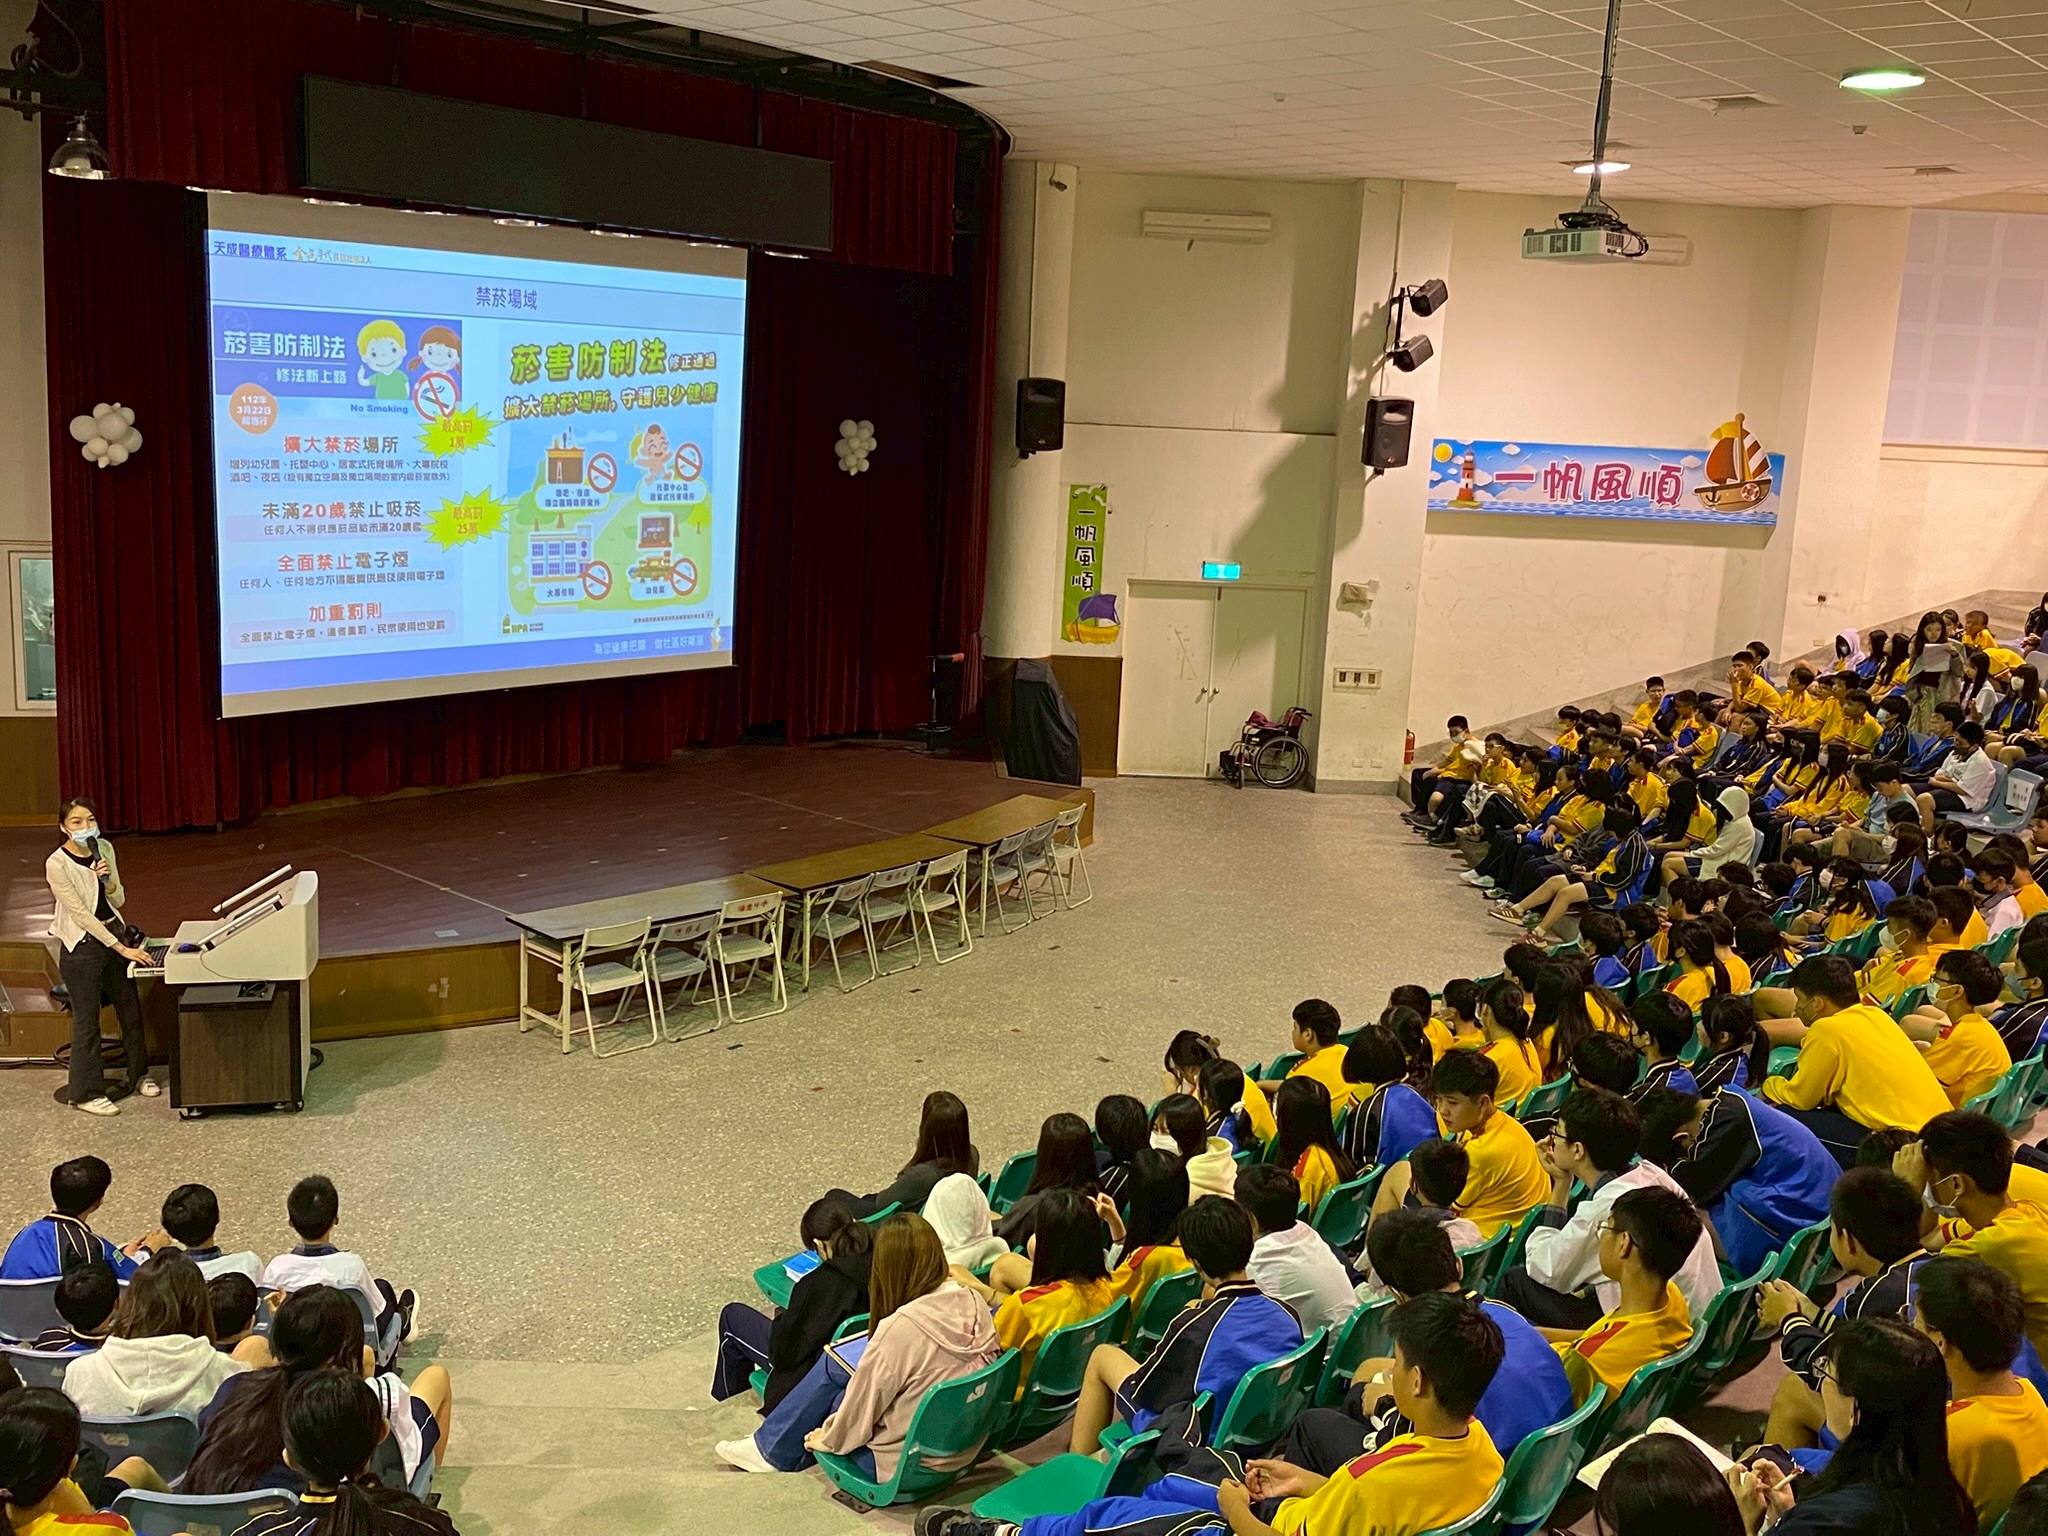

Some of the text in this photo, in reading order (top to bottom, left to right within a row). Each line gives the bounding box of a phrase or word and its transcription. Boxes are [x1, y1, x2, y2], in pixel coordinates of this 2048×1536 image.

[213, 241, 287, 260] 天成醫療體系
[476, 286, 537, 310] 禁菸場域
[223, 330, 346, 359] 菸害防制法
[510, 337, 668, 384] 菸害防制法
[276, 367, 347, 385] 修法新上路
[236, 405, 272, 415] 3月22日
[350, 404, 408, 414] No Smoking
[284, 435, 399, 454] 擴大禁菸場所
[1494, 461, 1684, 508] 一帆風順
[262, 501, 421, 520] 未滿20歲禁止吸菸
[1072, 510, 1097, 591] 一帆風順
[277, 551, 409, 572] 全面禁止電子煙
[309, 602, 382, 622] 加重罰則
[511, 624, 529, 633] HPA
